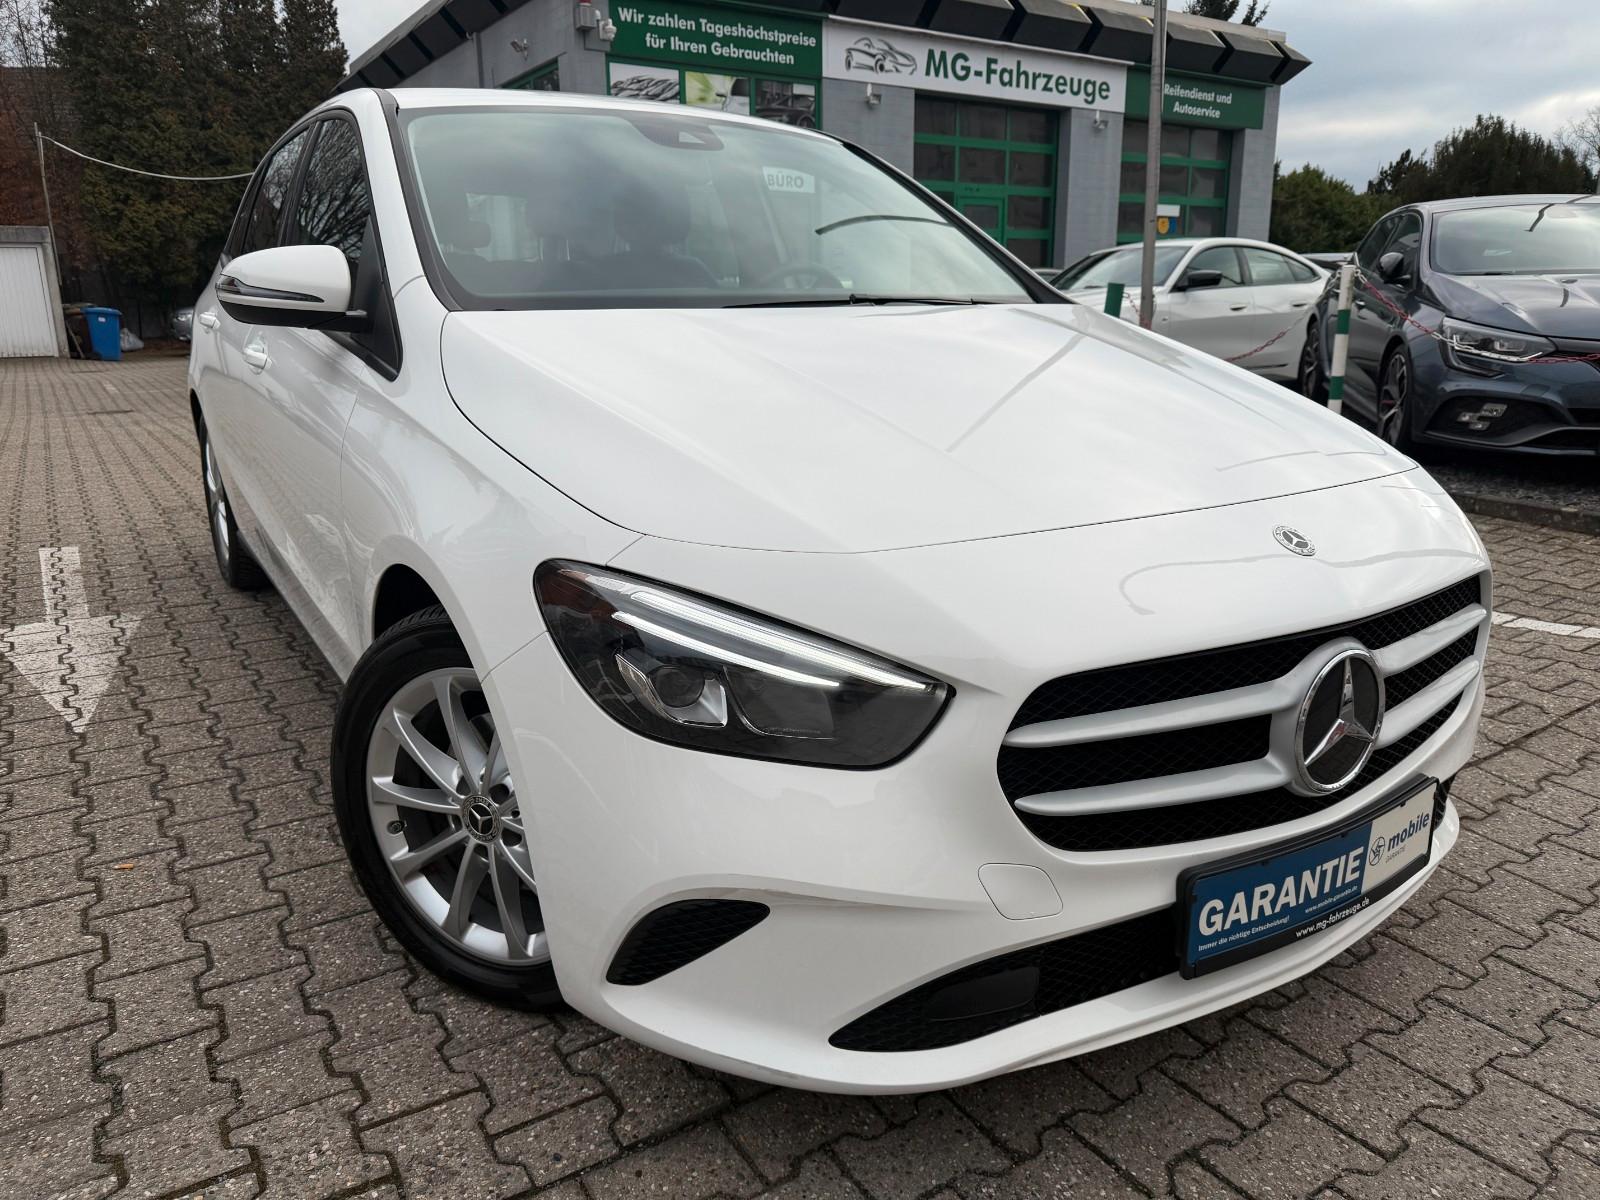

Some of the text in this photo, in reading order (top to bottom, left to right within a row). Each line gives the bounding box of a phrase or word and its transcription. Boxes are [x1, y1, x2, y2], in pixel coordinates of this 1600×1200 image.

[618, 7, 816, 47] Wir zahlen Tageshöchstpreise
[645, 33, 794, 64] für Ihren Gebrauchten
[925, 48, 1110, 105] MG-Fahrzeuge
[1164, 83, 1232, 104] Reifendienst und
[1173, 101, 1221, 118] Autoservice
[767, 171, 804, 189] BÜRO
[1387, 812, 1430, 851] mobile
[1198, 846, 1364, 936] GARANTIE
[1295, 896, 1370, 938] www.mg-fahrzeuge.de
